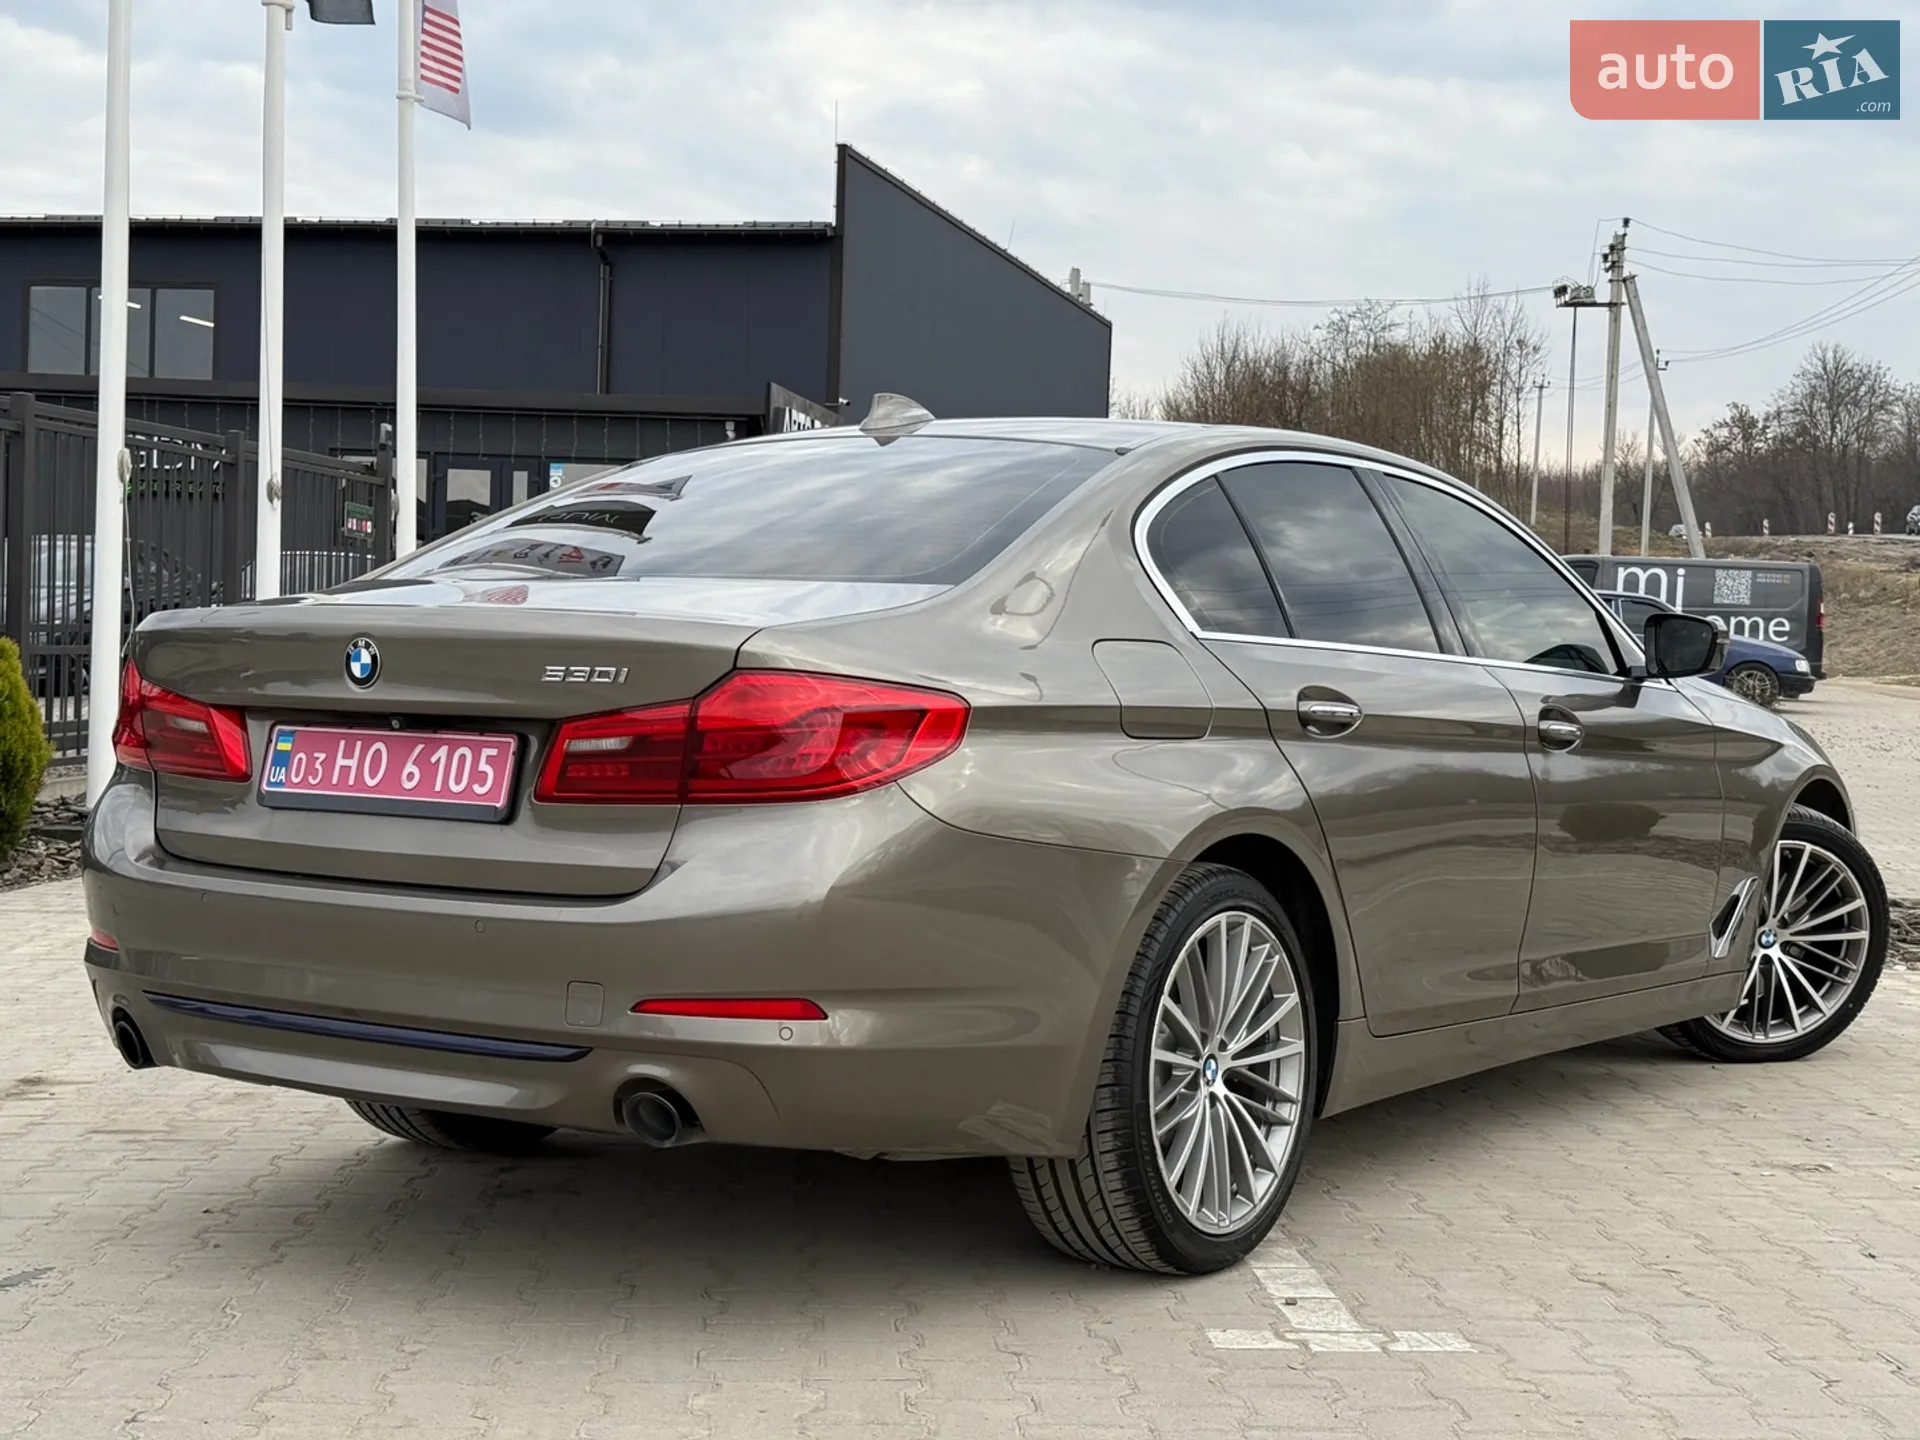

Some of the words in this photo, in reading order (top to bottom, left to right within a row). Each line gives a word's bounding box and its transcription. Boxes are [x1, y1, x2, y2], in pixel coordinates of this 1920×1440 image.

[347, 640, 376, 655] BMW
[270, 766, 286, 782] UA
[290, 752, 327, 785] 03
[400, 743, 499, 795] 6105
